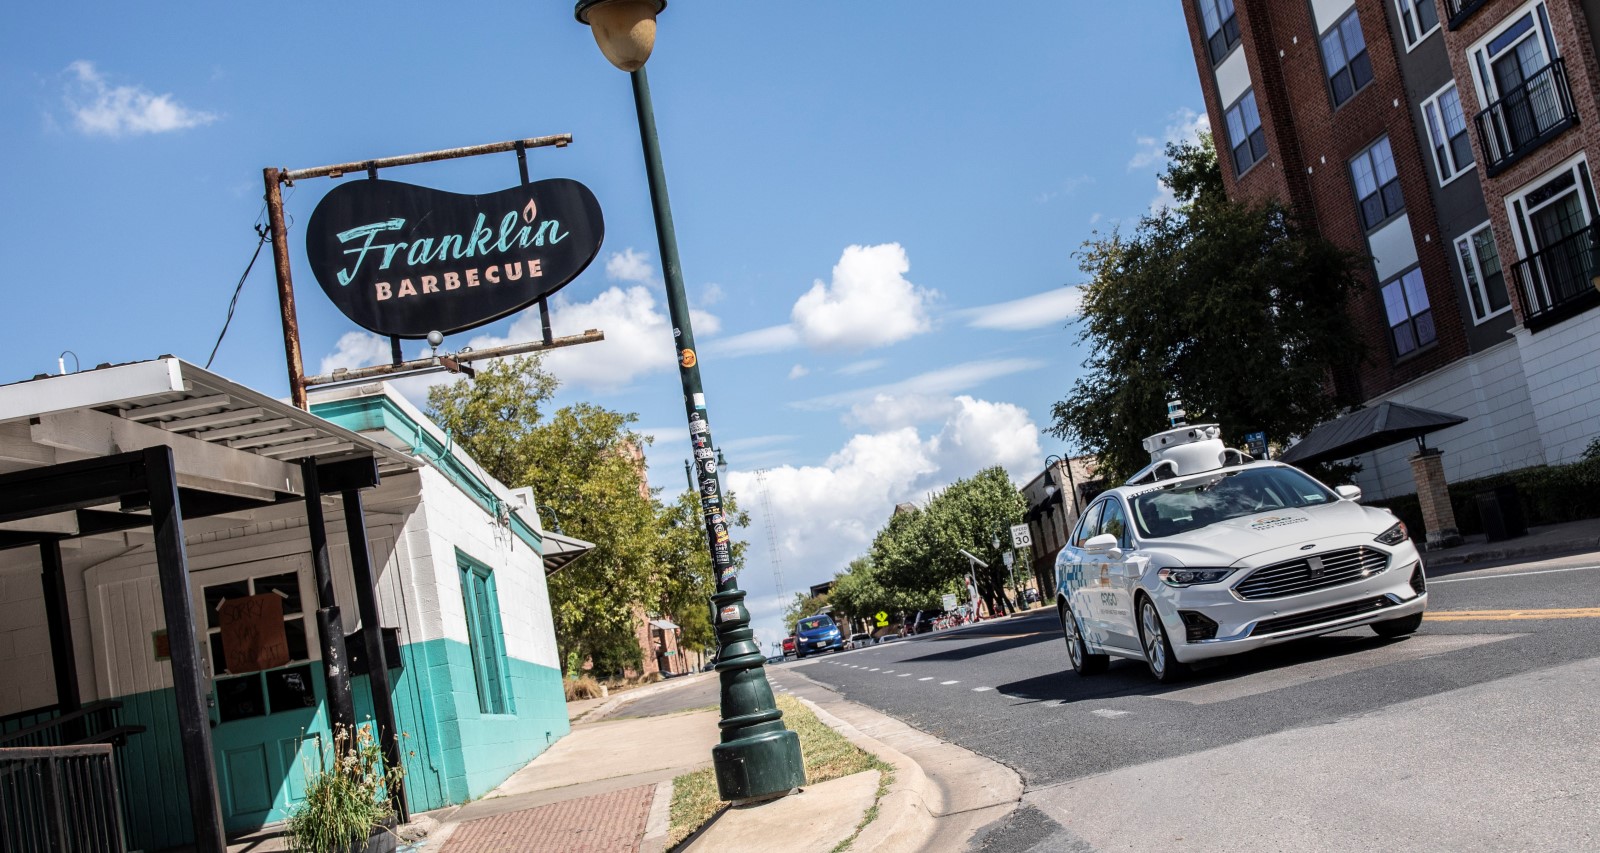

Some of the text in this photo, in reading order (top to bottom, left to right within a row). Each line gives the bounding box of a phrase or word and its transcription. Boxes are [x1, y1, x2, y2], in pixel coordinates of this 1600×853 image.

[336, 198, 569, 287] Franklin
[375, 259, 543, 301] BARBECUE
[1015, 535, 1029, 545] 30
[223, 598, 264, 624] SORRY
